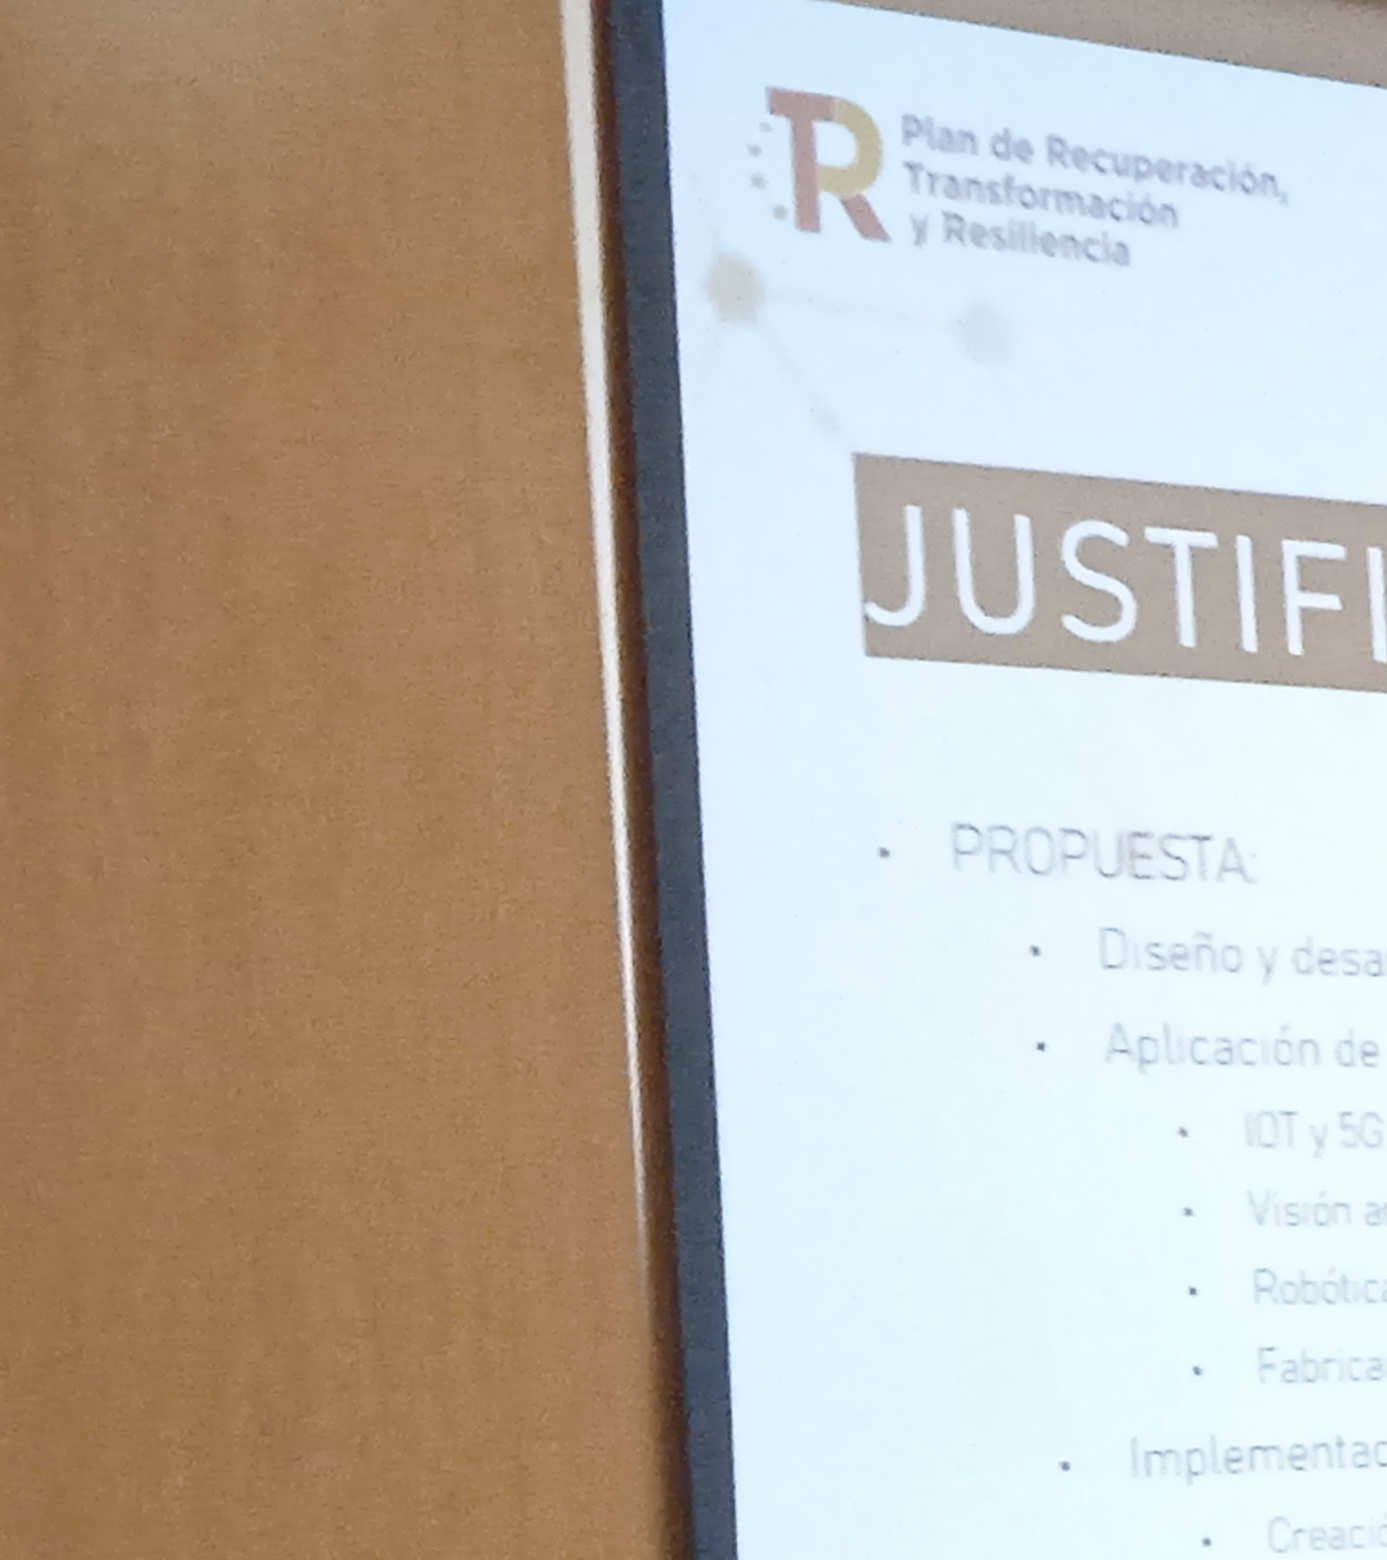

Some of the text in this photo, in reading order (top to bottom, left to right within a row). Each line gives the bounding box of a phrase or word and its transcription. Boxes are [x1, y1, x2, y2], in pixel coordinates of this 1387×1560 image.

[901, 113, 1288, 206] Plan de Recuperación,
[903, 160, 1178, 228] Transformación
[910, 209, 1130, 266] y Resiliencia
[1099, 926, 1243, 973] Diseño
[1256, 946, 1278, 986] y
[1105, 1023, 1319, 1075] Aplicación
[1336, 1030, 1380, 1069] de
[1309, 1121, 1329, 1158] y
[1338, 1111, 1383, 1150] 5G
[1247, 1189, 1352, 1227] Visión
